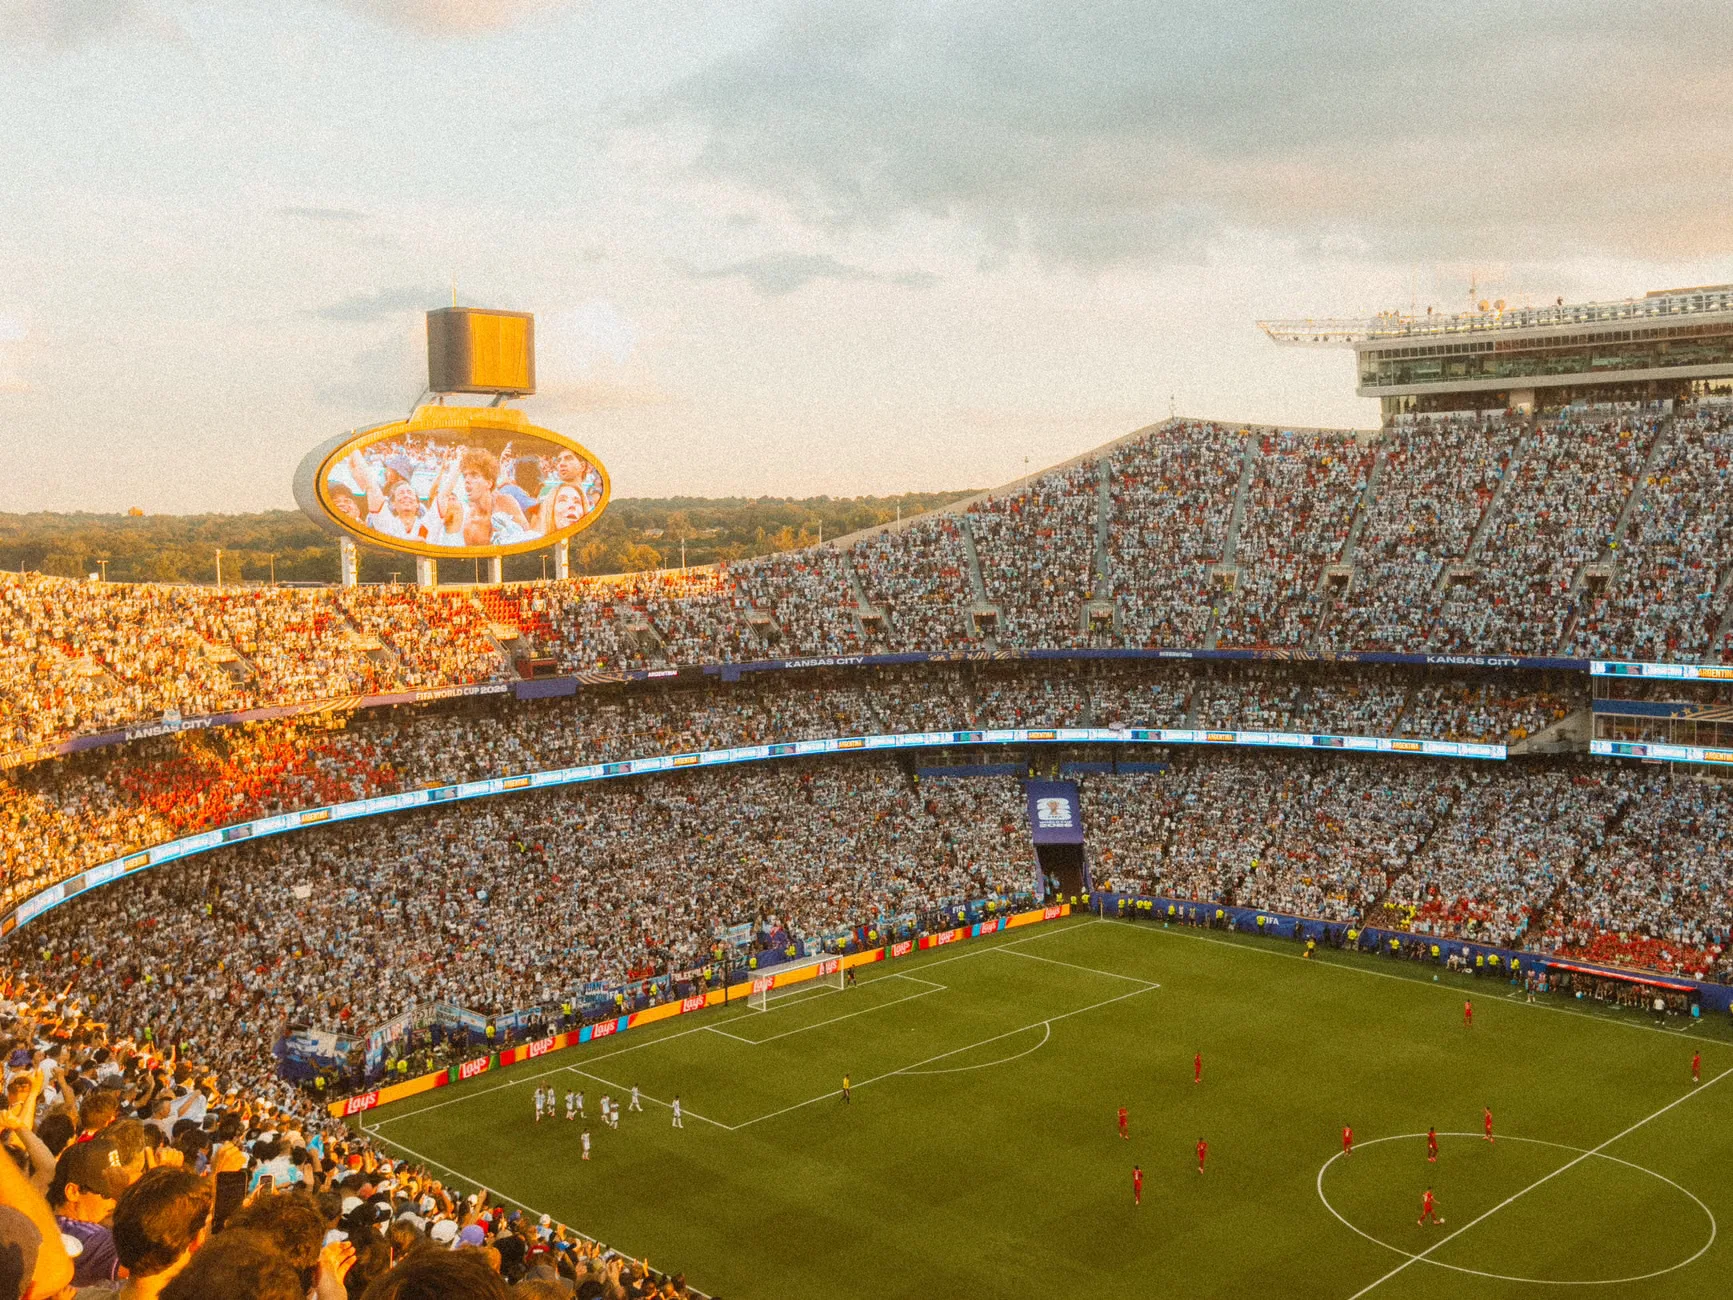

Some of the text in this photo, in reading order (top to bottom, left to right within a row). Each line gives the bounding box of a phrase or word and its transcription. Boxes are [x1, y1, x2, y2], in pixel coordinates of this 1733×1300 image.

[785, 657, 864, 669] KANSAS CITY
[1427, 656, 1520, 666] KANSAS CITY
[416, 684, 508, 701] FIFA WORLD CUP 2026
[125, 718, 212, 741] KANSAS CITY
[952, 904, 966, 914] FIFA
